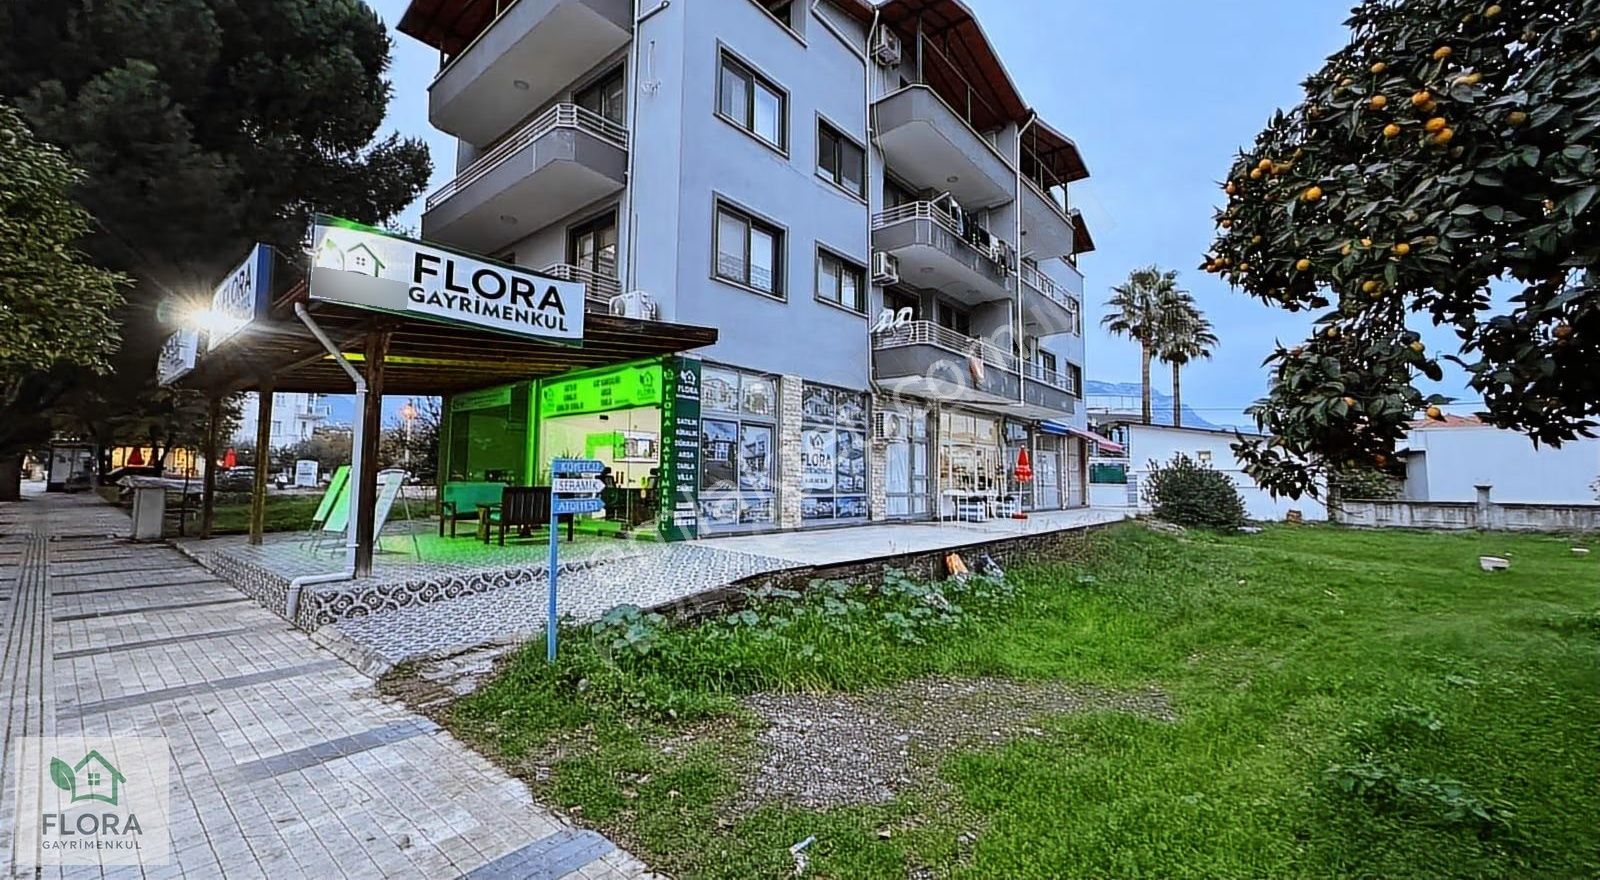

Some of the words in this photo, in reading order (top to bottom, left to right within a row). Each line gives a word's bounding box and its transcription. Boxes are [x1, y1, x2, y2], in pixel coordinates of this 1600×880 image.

[413, 251, 567, 316] FLORA
[408, 287, 568, 333] GAYRİMENKUL
[663, 384, 672, 427] FLORA
[677, 384, 698, 394] FLORA
[801, 453, 837, 467] FLORA
